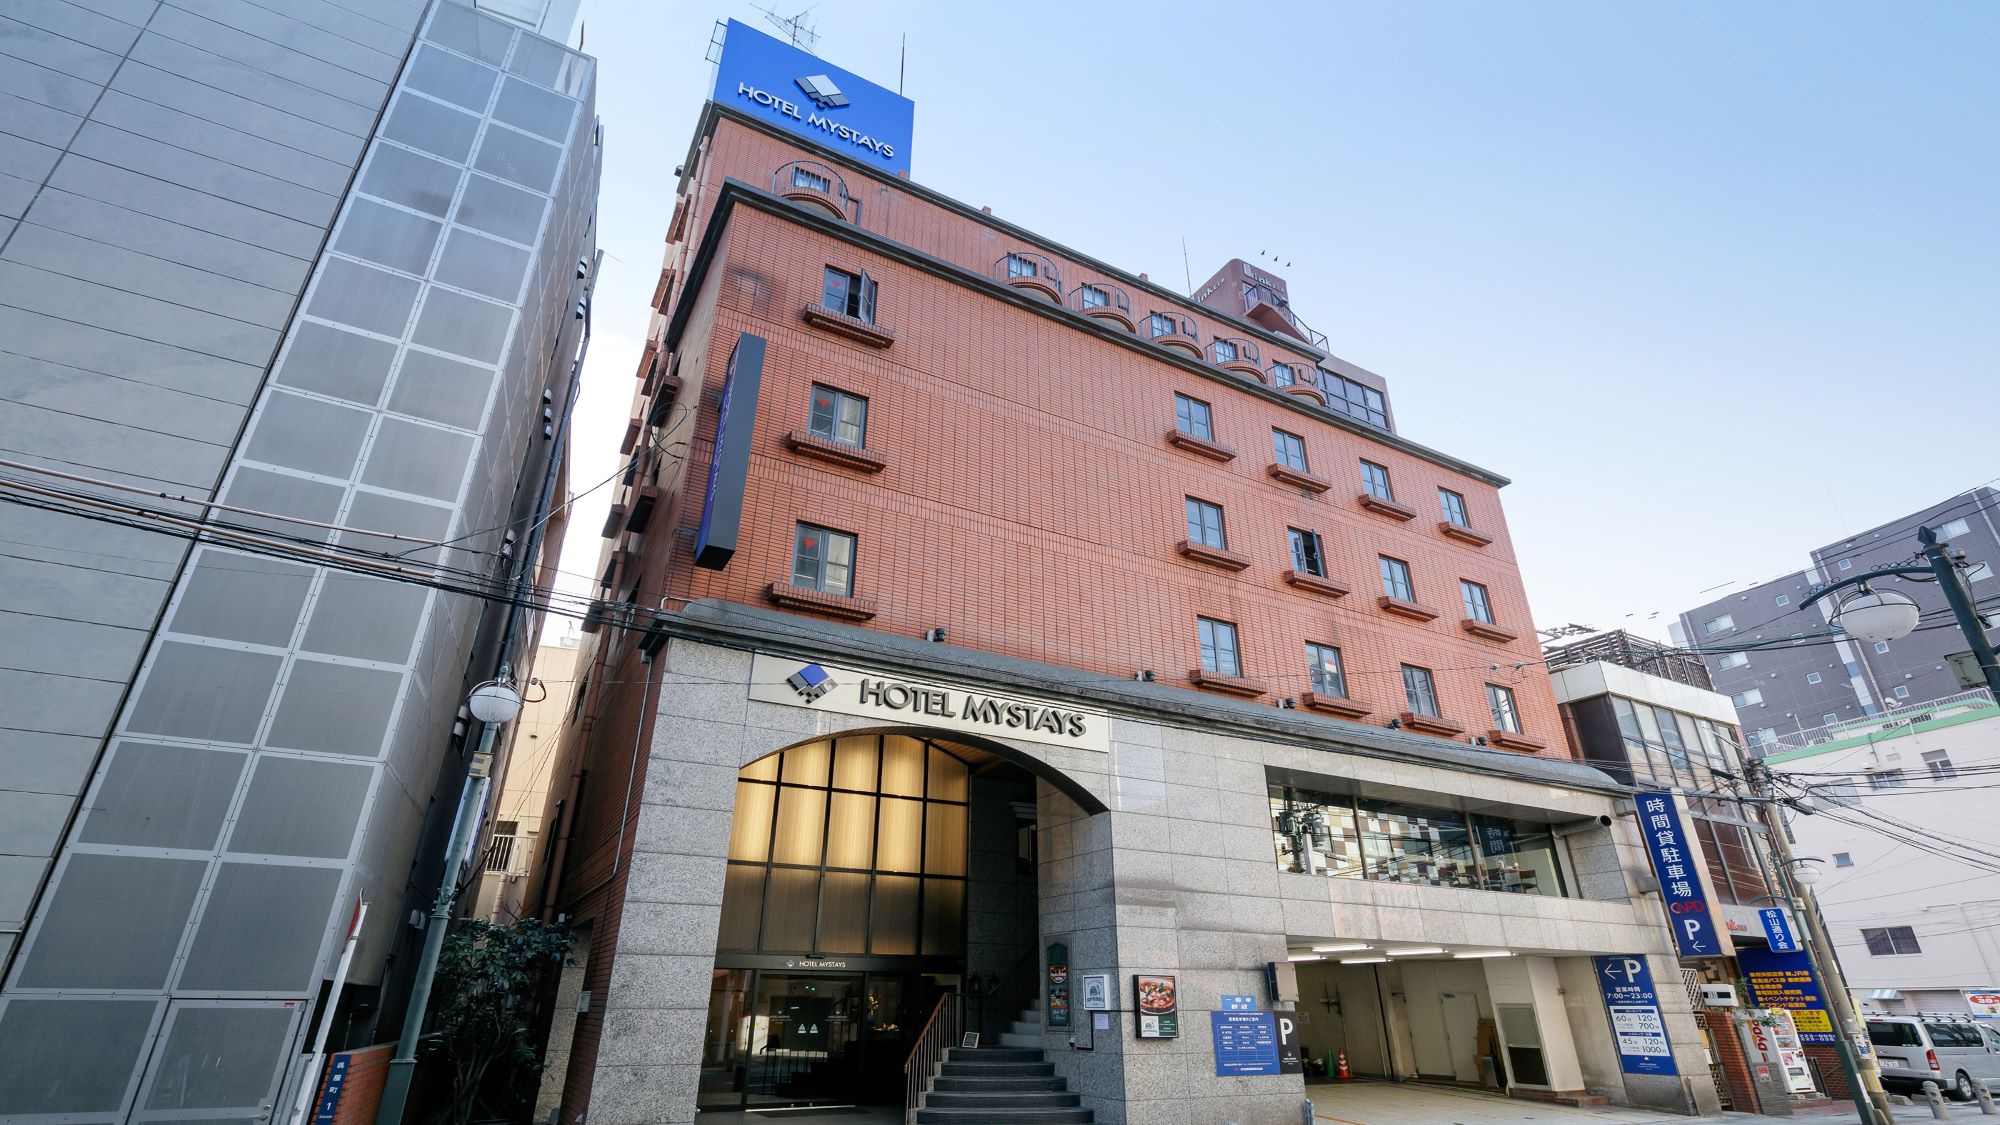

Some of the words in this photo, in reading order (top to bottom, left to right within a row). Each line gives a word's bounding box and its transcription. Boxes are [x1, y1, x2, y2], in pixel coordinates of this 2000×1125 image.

[738, 81, 802, 120] HOTEL
[807, 110, 895, 159] MYSTAYS
[860, 678, 957, 717] HOTEL
[962, 694, 1087, 737] MYSTAYS
[1645, 797, 1692, 898] 時間貸駐車場
[1683, 919, 1700, 941] P
[1765, 910, 1789, 949] 松山通り会
[799, 960, 818, 968] HOTEL
[1623, 959, 1642, 983] P
[1279, 1018, 1294, 1045] P
